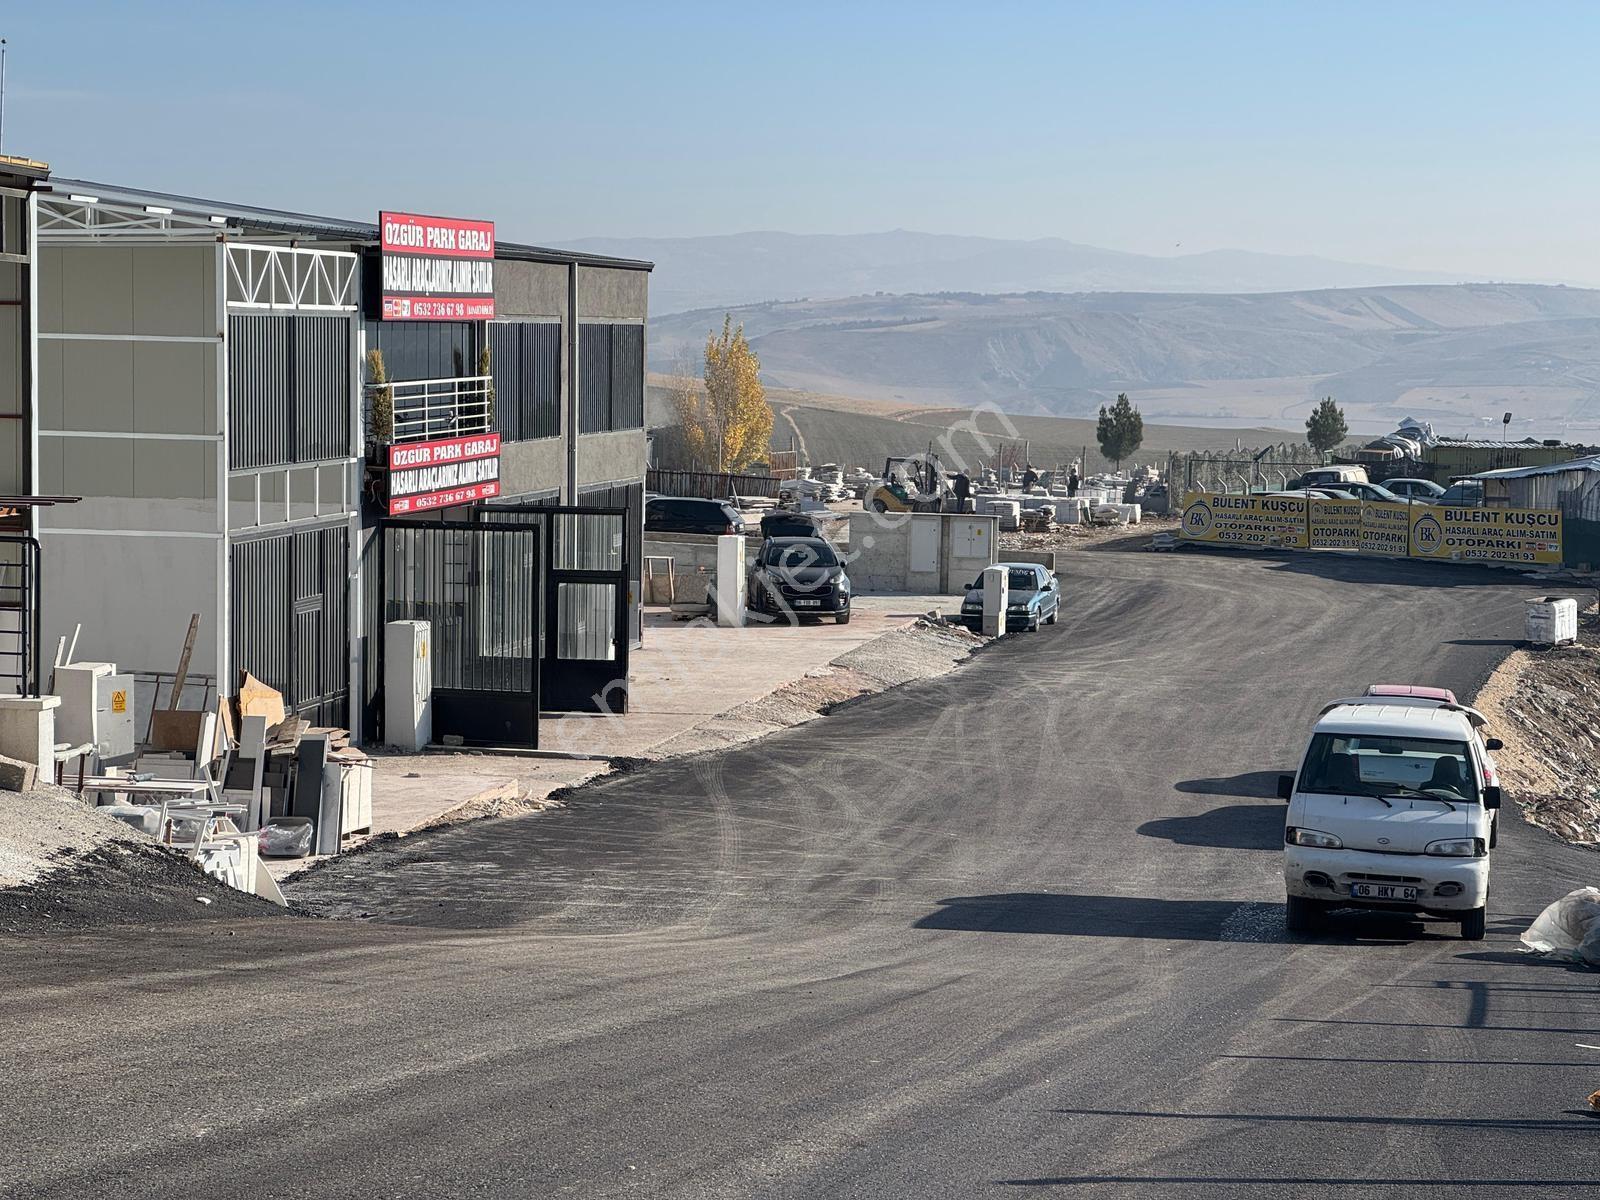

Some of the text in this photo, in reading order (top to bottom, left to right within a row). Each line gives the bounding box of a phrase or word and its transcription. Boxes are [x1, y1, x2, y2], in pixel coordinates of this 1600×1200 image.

[385, 217, 491, 252] ÖZGÜR PARK GARAJ
[383, 256, 411, 291] HASARLI
[414, 302, 431, 316] 0532
[433, 303, 446, 316] 736
[446, 303, 455, 316] 67
[456, 303, 464, 316] 98
[393, 439, 497, 466] ÖZGÜR PARK GARAJ
[391, 470, 418, 496] HASARLI
[416, 496, 437, 508] 0532
[439, 493, 454, 503] 736
[455, 491, 465, 500] 67
[466, 489, 476, 498] 98
[1261, 500, 1304, 514] KUŞCU
[1244, 514, 1263, 523] ARAÇ
[1504, 512, 1559, 528] KUŞCU
[1218, 532, 1243, 540] 0532
[1246, 534, 1266, 542] 202
[1285, 536, 1298, 544] 93
[1313, 528, 1359, 537] OTOPARKI
[1362, 531, 1406, 543] OTOPARKI
[1420, 527, 1436, 542] BK
[1445, 527, 1557, 539] HASARLI ARAÇ ALIM-SATIM
[1361, 542, 1376, 550] 0532
[1389, 544, 1397, 552] 91
[1445, 538, 1522, 549] OTOPARKI
[1465, 550, 1535, 560] 0532 202 91 93
[1358, 885, 1415, 899] 06 HKY 64
